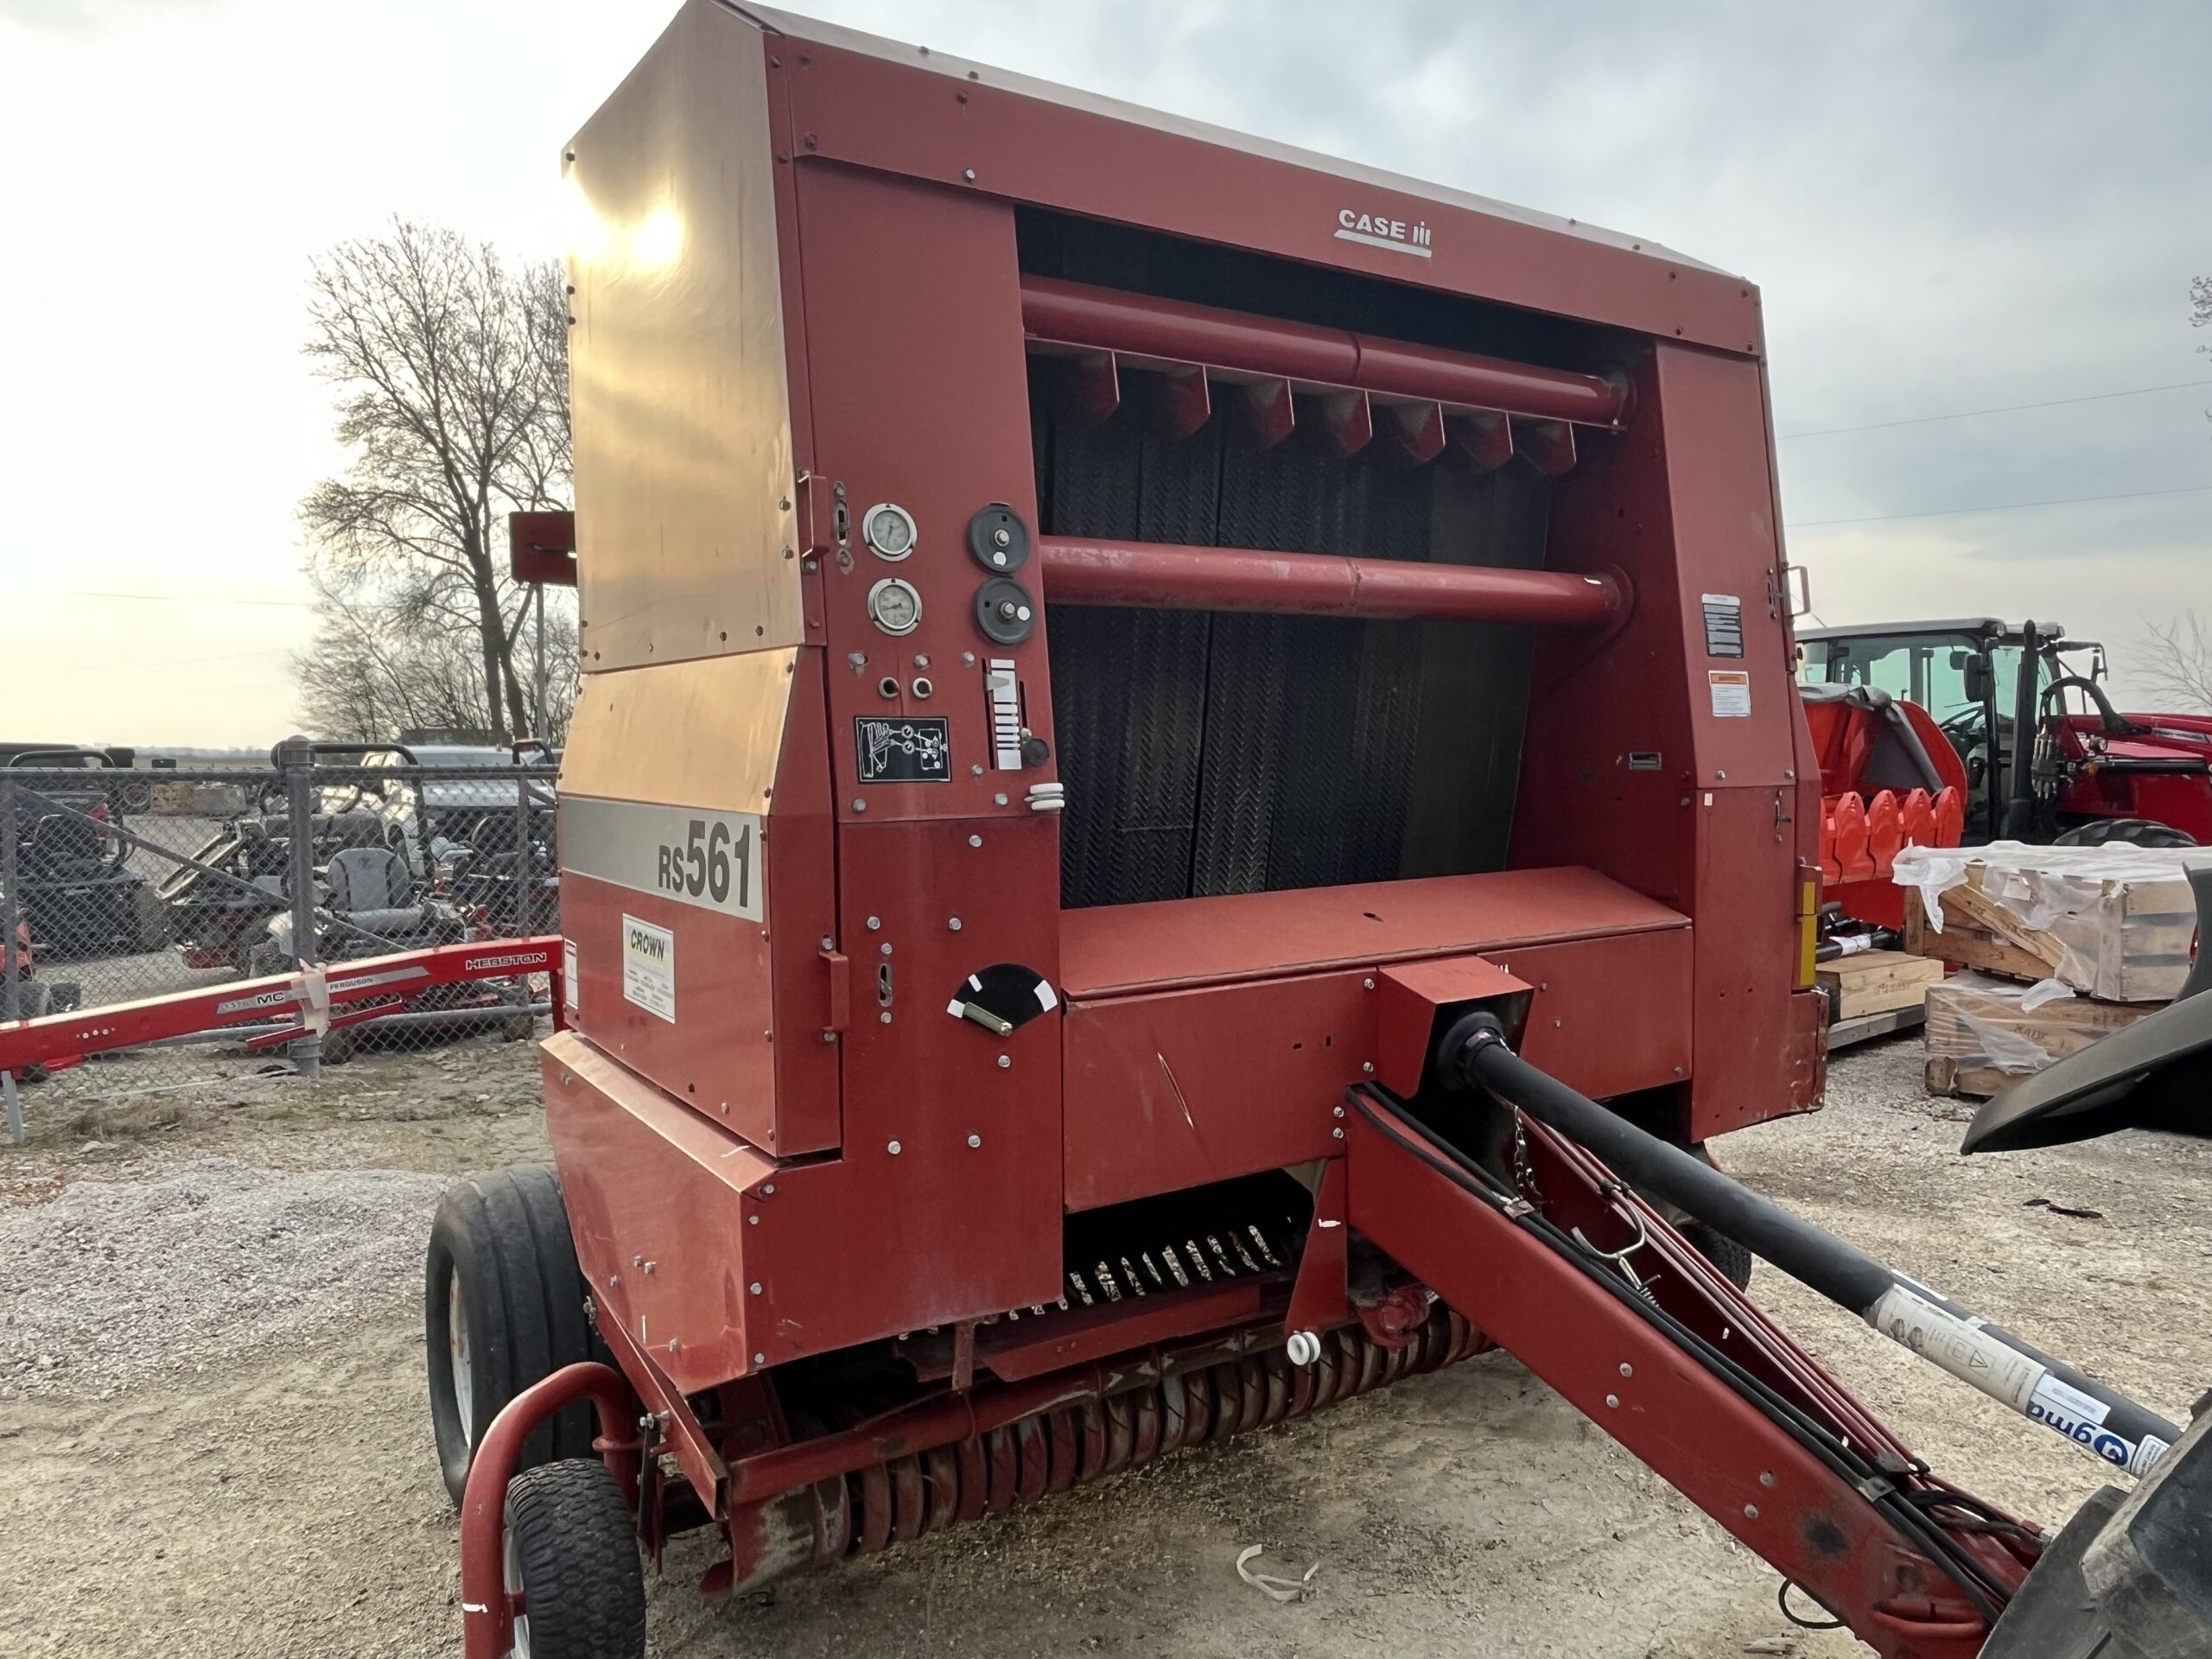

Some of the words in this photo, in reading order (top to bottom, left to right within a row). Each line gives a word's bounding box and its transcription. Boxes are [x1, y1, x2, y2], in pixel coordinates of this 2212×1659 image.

[1338, 209, 1406, 239] CASE
[631, 929, 665, 961] CROWN
[465, 952, 547, 970] HESSTON
[329, 977, 373, 990] FERGUSON
[257, 992, 284, 1004] MC
